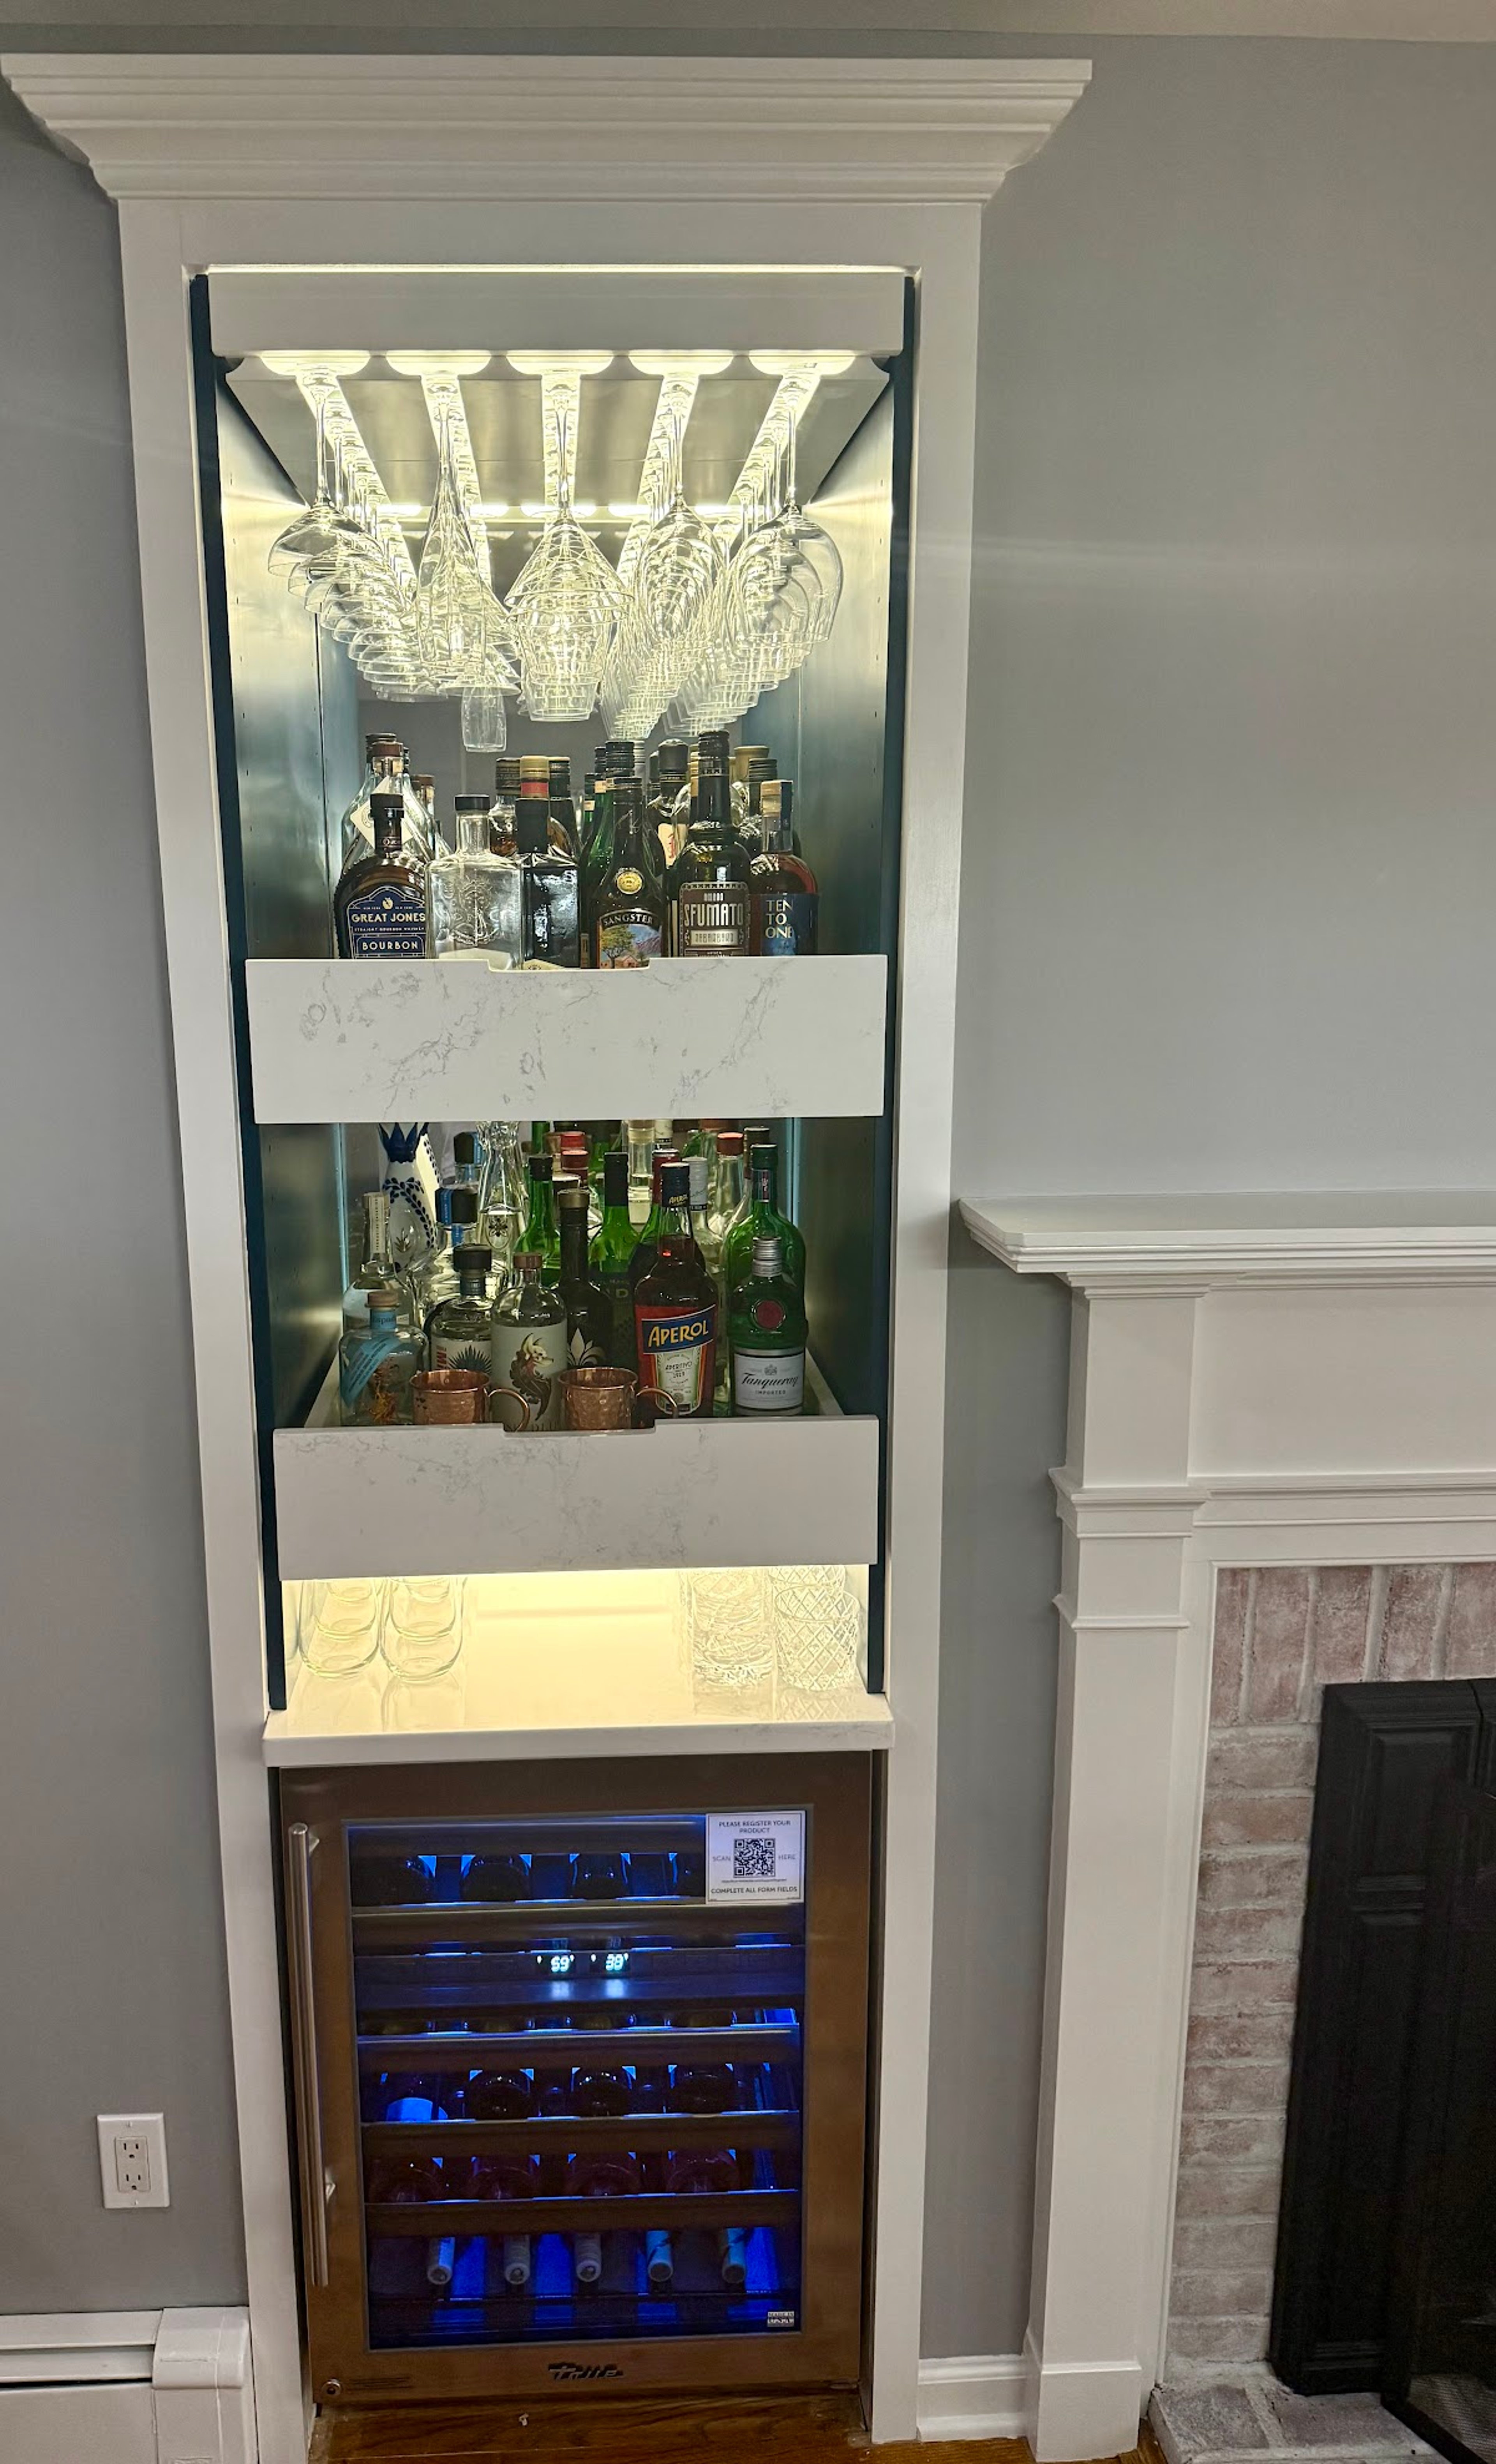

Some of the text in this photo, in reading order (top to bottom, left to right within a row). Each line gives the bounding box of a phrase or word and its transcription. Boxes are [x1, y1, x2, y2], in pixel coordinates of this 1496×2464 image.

[766, 900, 793, 911] TEN
[351, 913, 425, 922] GREAT JONES
[684, 904, 743, 926] SFUMATO
[766, 913, 787, 925] TO
[765, 926, 794, 938] ONE
[362, 941, 418, 950] BOURBON
[648, 1320, 709, 1347] APEROL
[742, 1372, 798, 1389] Tanqueray
